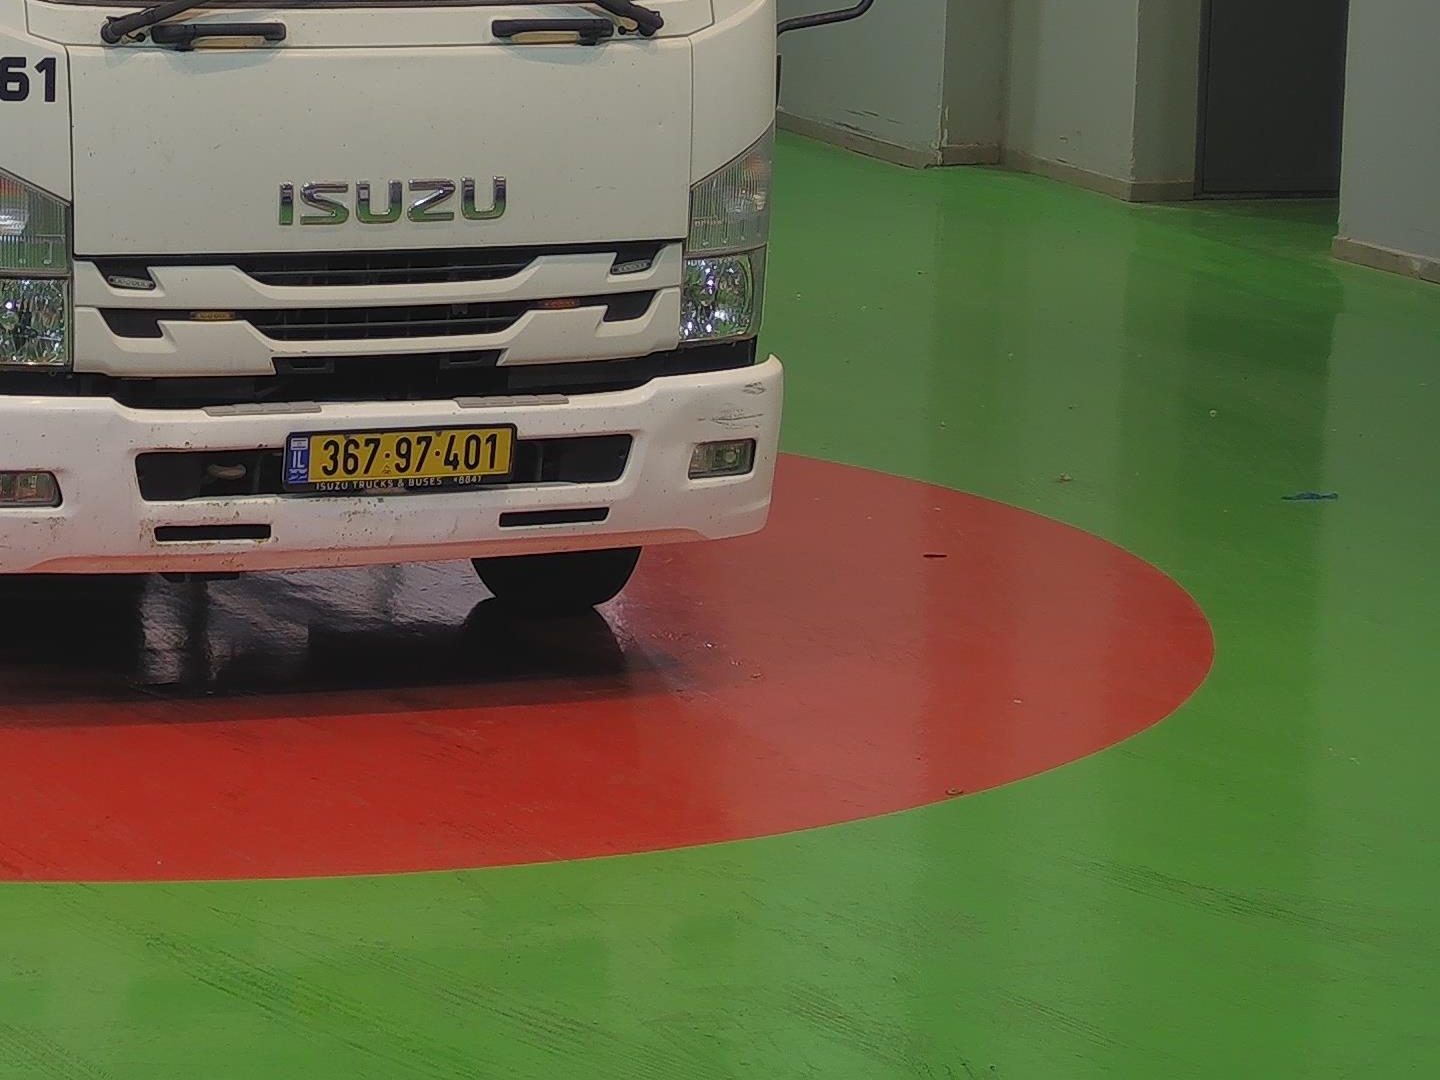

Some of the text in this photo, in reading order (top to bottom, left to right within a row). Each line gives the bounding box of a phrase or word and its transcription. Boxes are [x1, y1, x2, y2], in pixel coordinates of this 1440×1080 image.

[278, 175, 507, 226] ISUZU
[292, 450, 305, 468] IL
[315, 481, 348, 491] ISUZU
[352, 479, 394, 490] TRUCKS
[397, 480, 404, 488] &
[408, 477, 443, 487] BUSES
